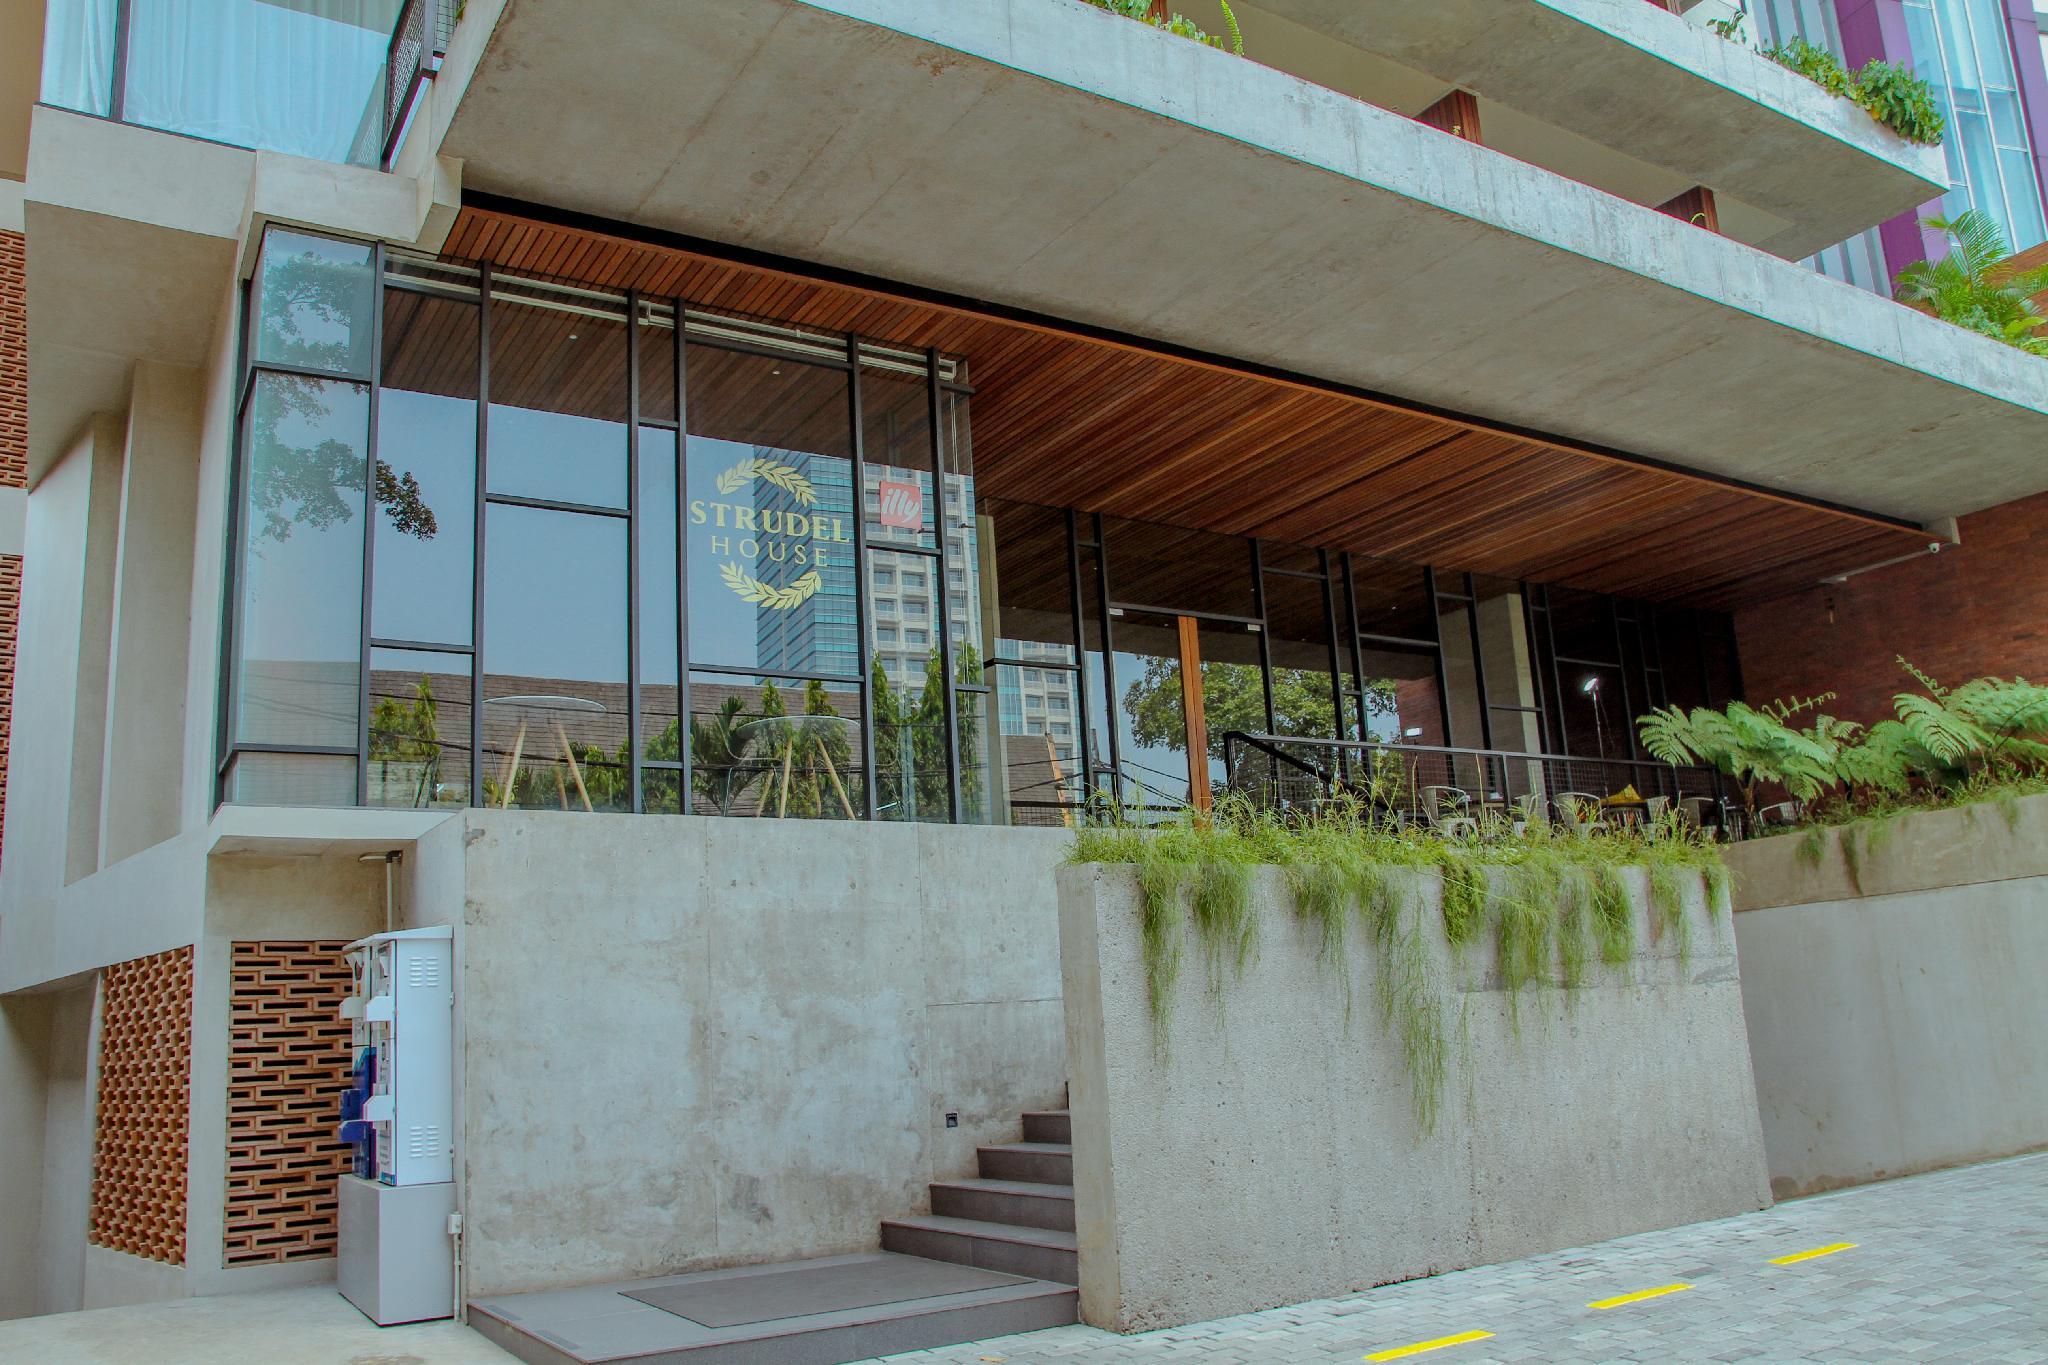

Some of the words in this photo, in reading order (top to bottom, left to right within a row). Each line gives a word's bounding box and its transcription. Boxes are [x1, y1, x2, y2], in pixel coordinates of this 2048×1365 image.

[690, 501, 850, 543] STRUDEL
[881, 488, 920, 523] illy
[710, 535, 829, 568] HOUSE
